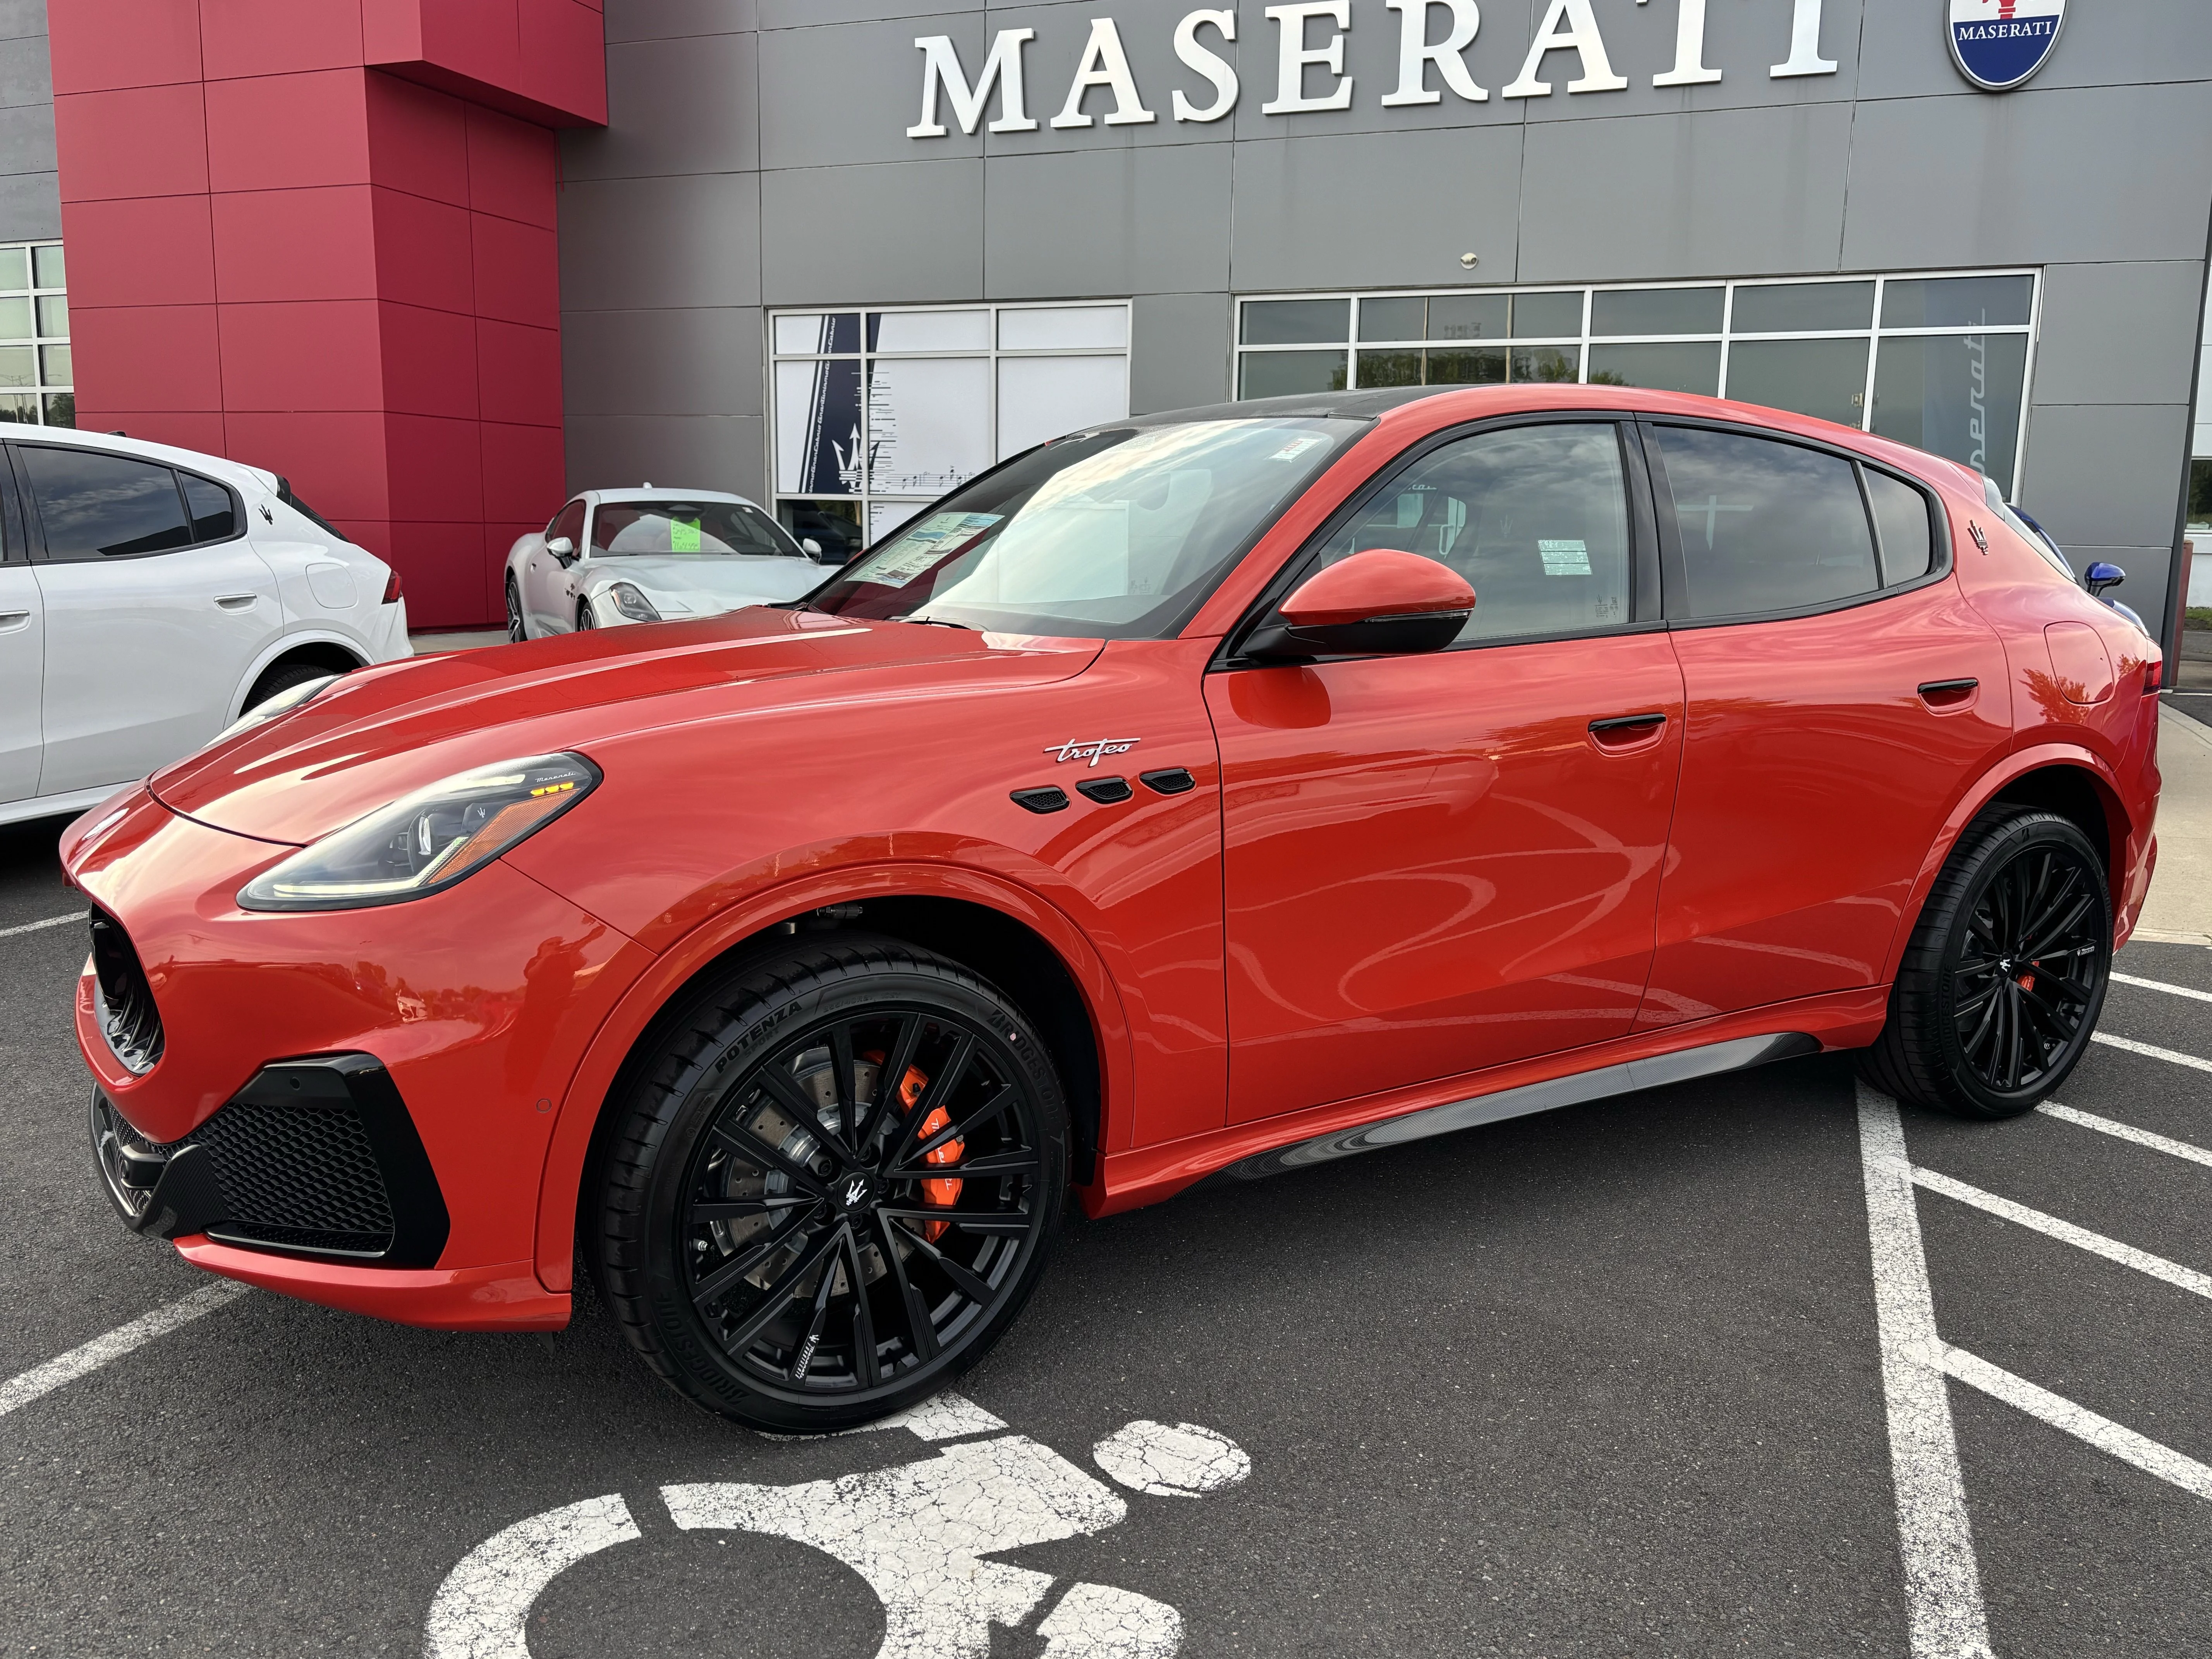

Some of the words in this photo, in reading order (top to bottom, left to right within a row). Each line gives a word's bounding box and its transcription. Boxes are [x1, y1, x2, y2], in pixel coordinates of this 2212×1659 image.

[1958, 21, 2052, 41] MASERATI
[906, 0, 1839, 139] MASERATI
[1044, 737, 1141, 767] trofeo
[535, 772, 576, 782] Maserati
[715, 1001, 802, 1074] POTENZA
[744, 1026, 780, 1058] SPORT
[656, 1291, 751, 1405] BRIDGESTONE
